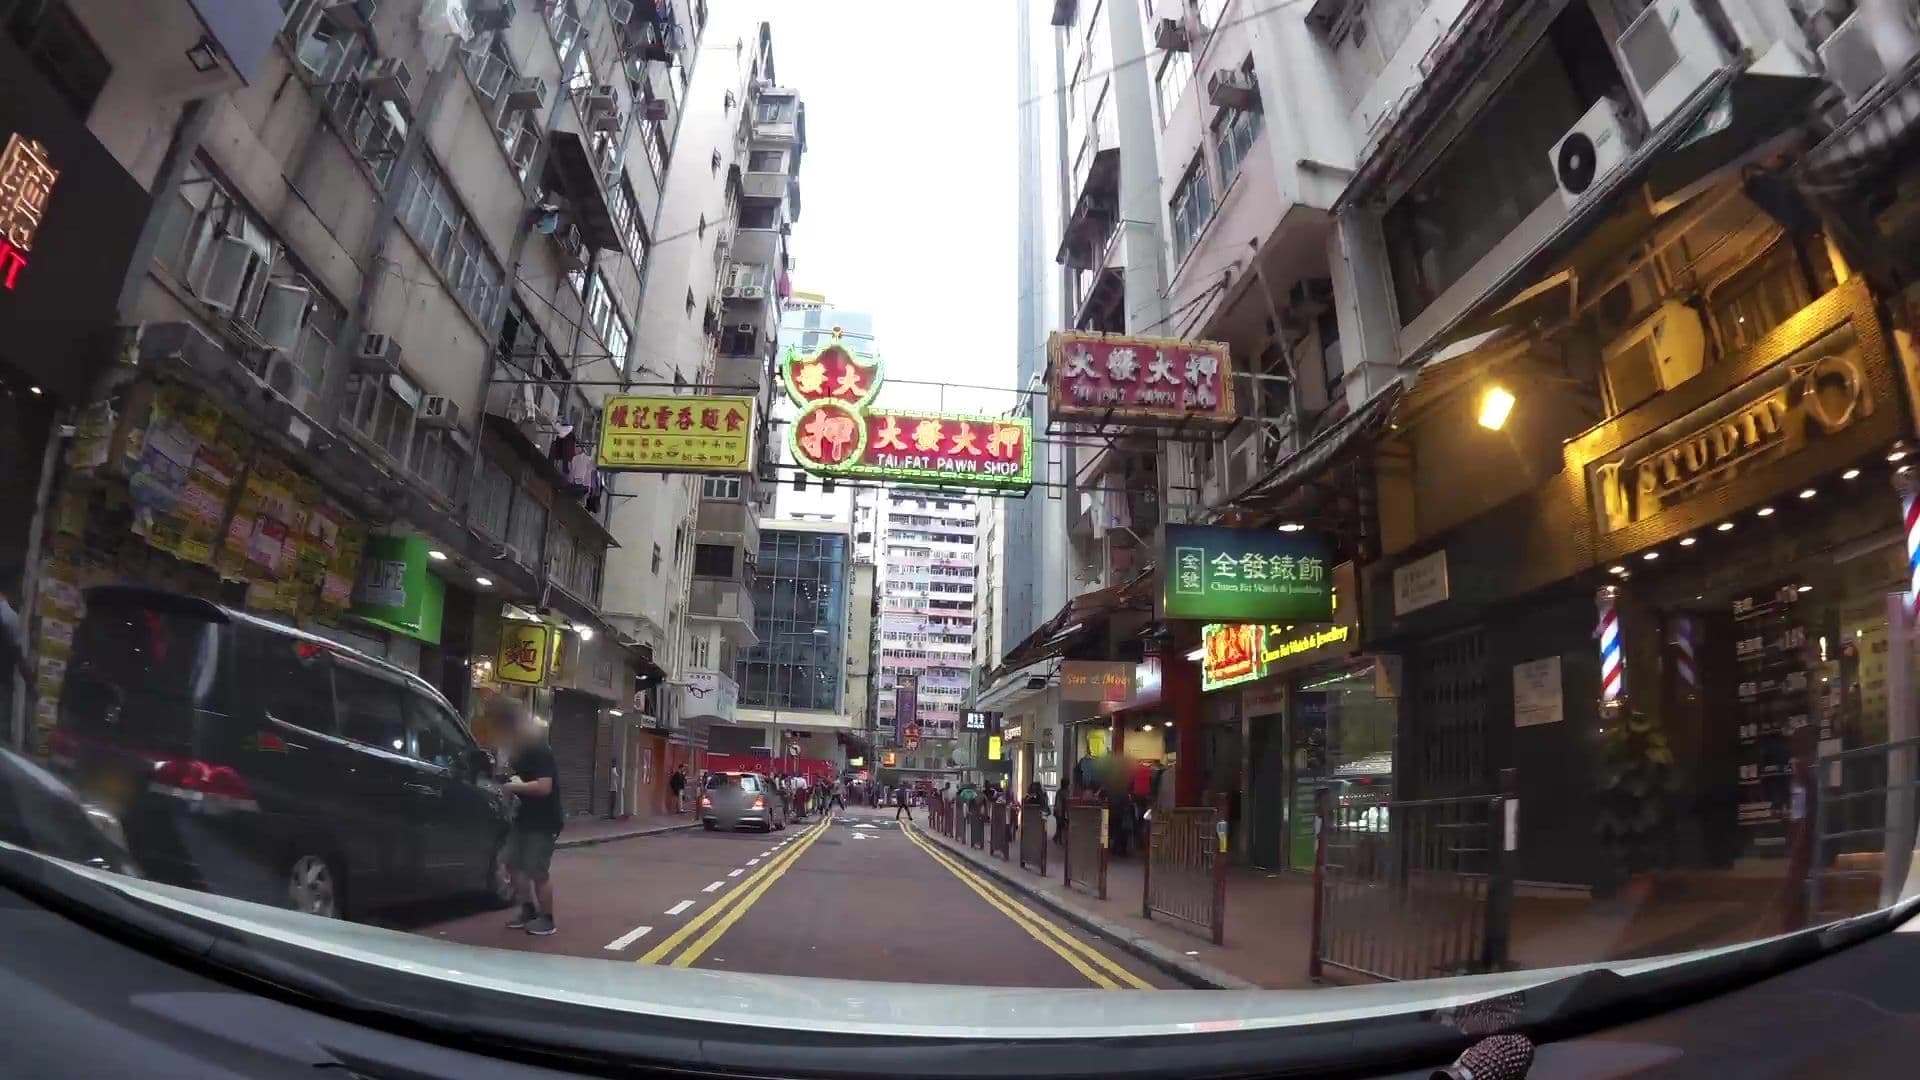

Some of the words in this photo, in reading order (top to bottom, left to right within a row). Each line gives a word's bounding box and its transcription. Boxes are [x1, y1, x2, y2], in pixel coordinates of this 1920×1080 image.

[800, 409, 855, 461] 押
[874, 416, 1021, 458] 大發大押
[877, 454, 898, 468] TAI
[904, 455, 929, 469] FAT
[937, 457, 976, 472] PAWN
[984, 461, 1018, 475] SHOP
[1181, 553, 1201, 588] 全發
[1210, 551, 1323, 582] 全發錶飾
